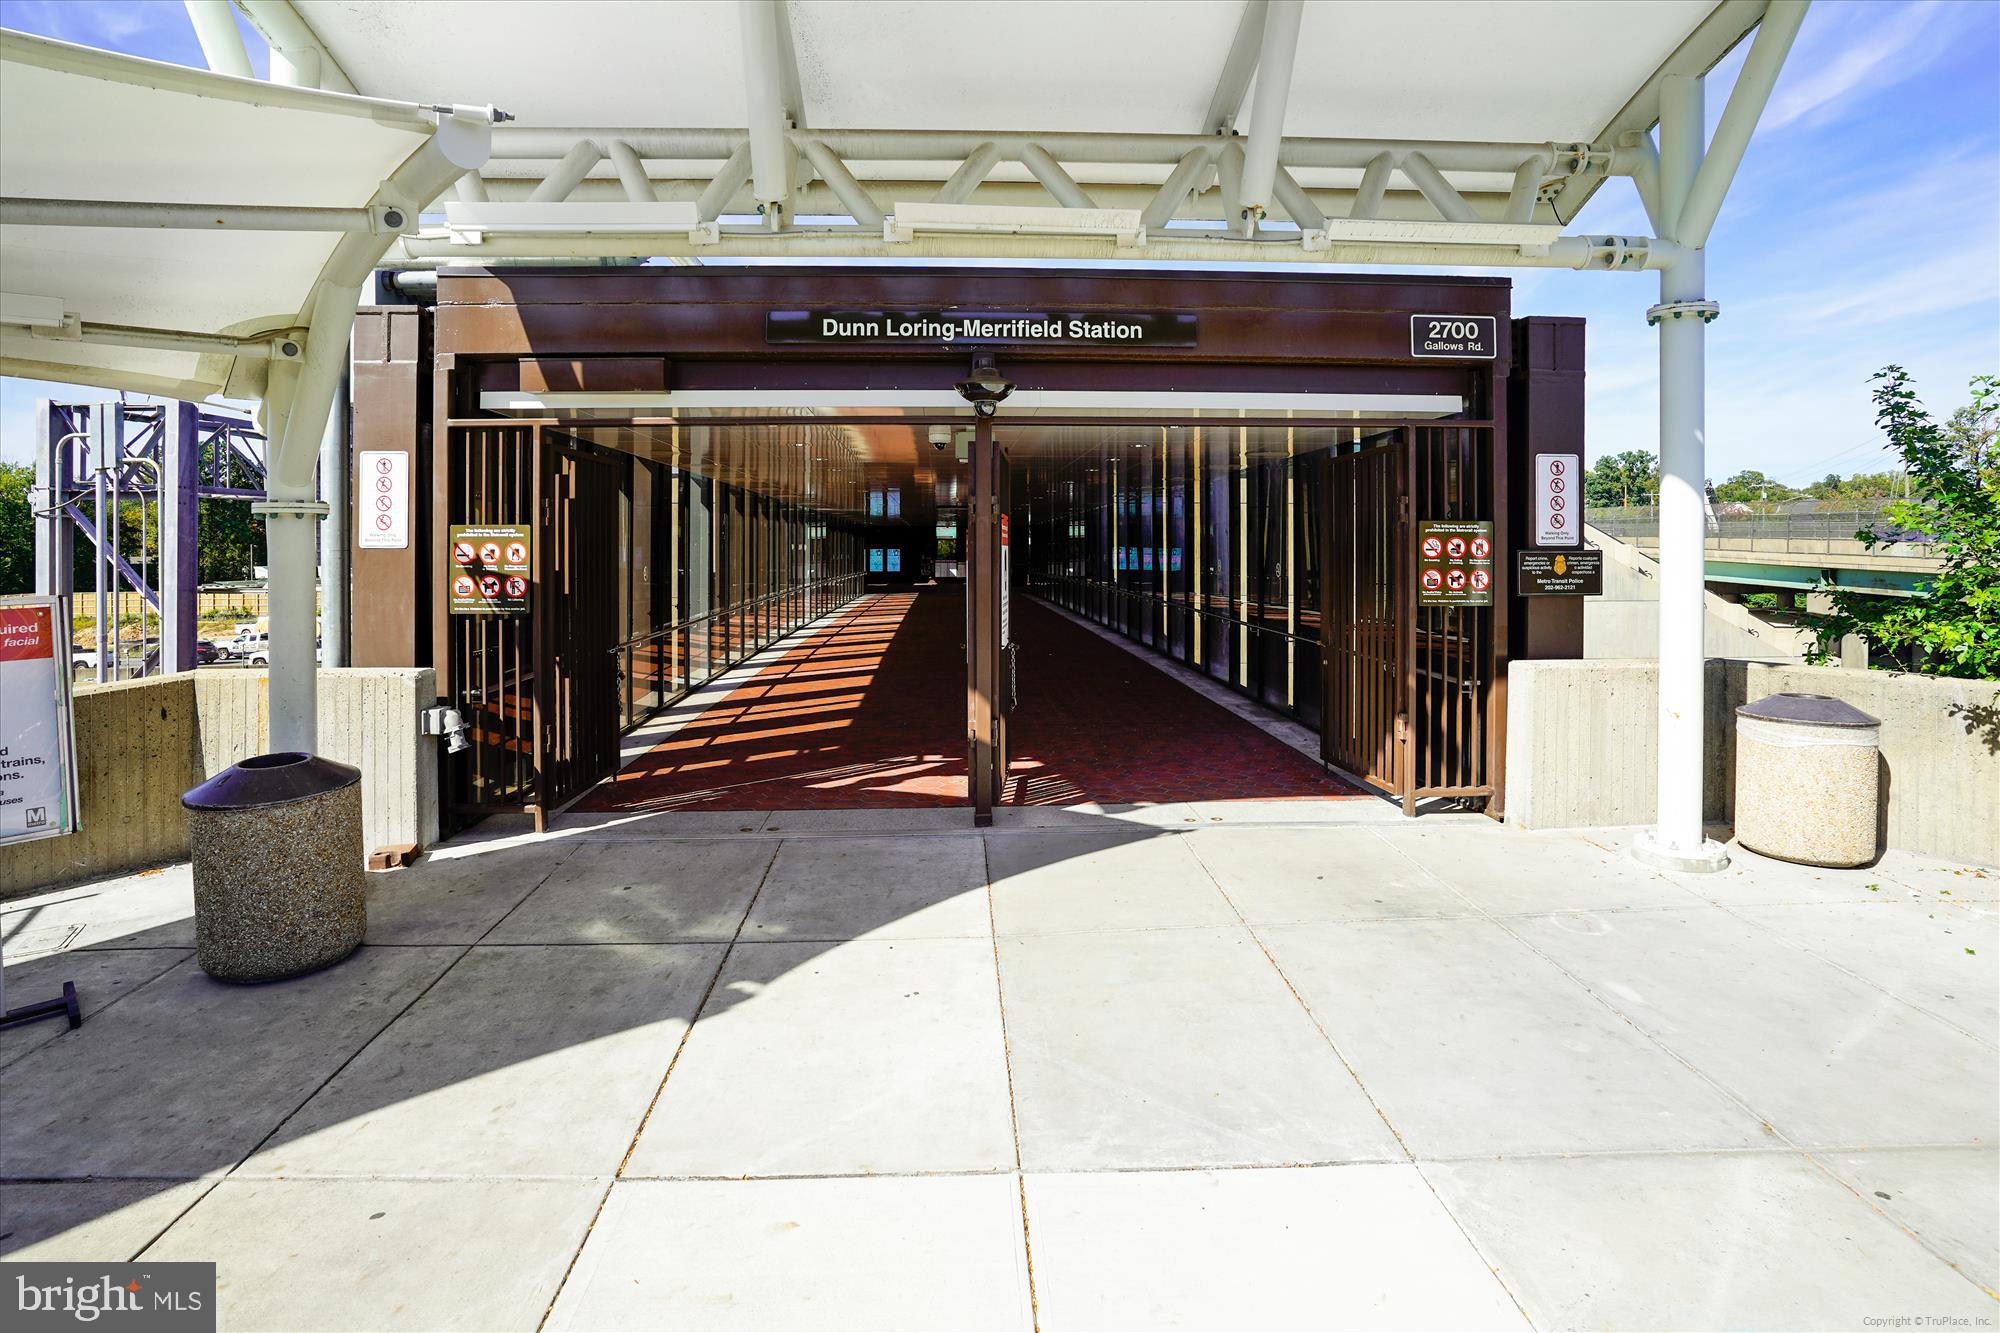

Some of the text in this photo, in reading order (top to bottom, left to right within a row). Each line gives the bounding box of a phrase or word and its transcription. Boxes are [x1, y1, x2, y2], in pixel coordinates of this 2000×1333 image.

[822, 318, 1143, 341] Dunn Loring-Merrifield Station
[1428, 321, 1479, 339] 2700
[1424, 341, 1484, 351] Gallows Rd.
[4, 636, 40, 647] facial
[1, 757, 46, 768] trains,
[0, 772, 24, 781] ns.
